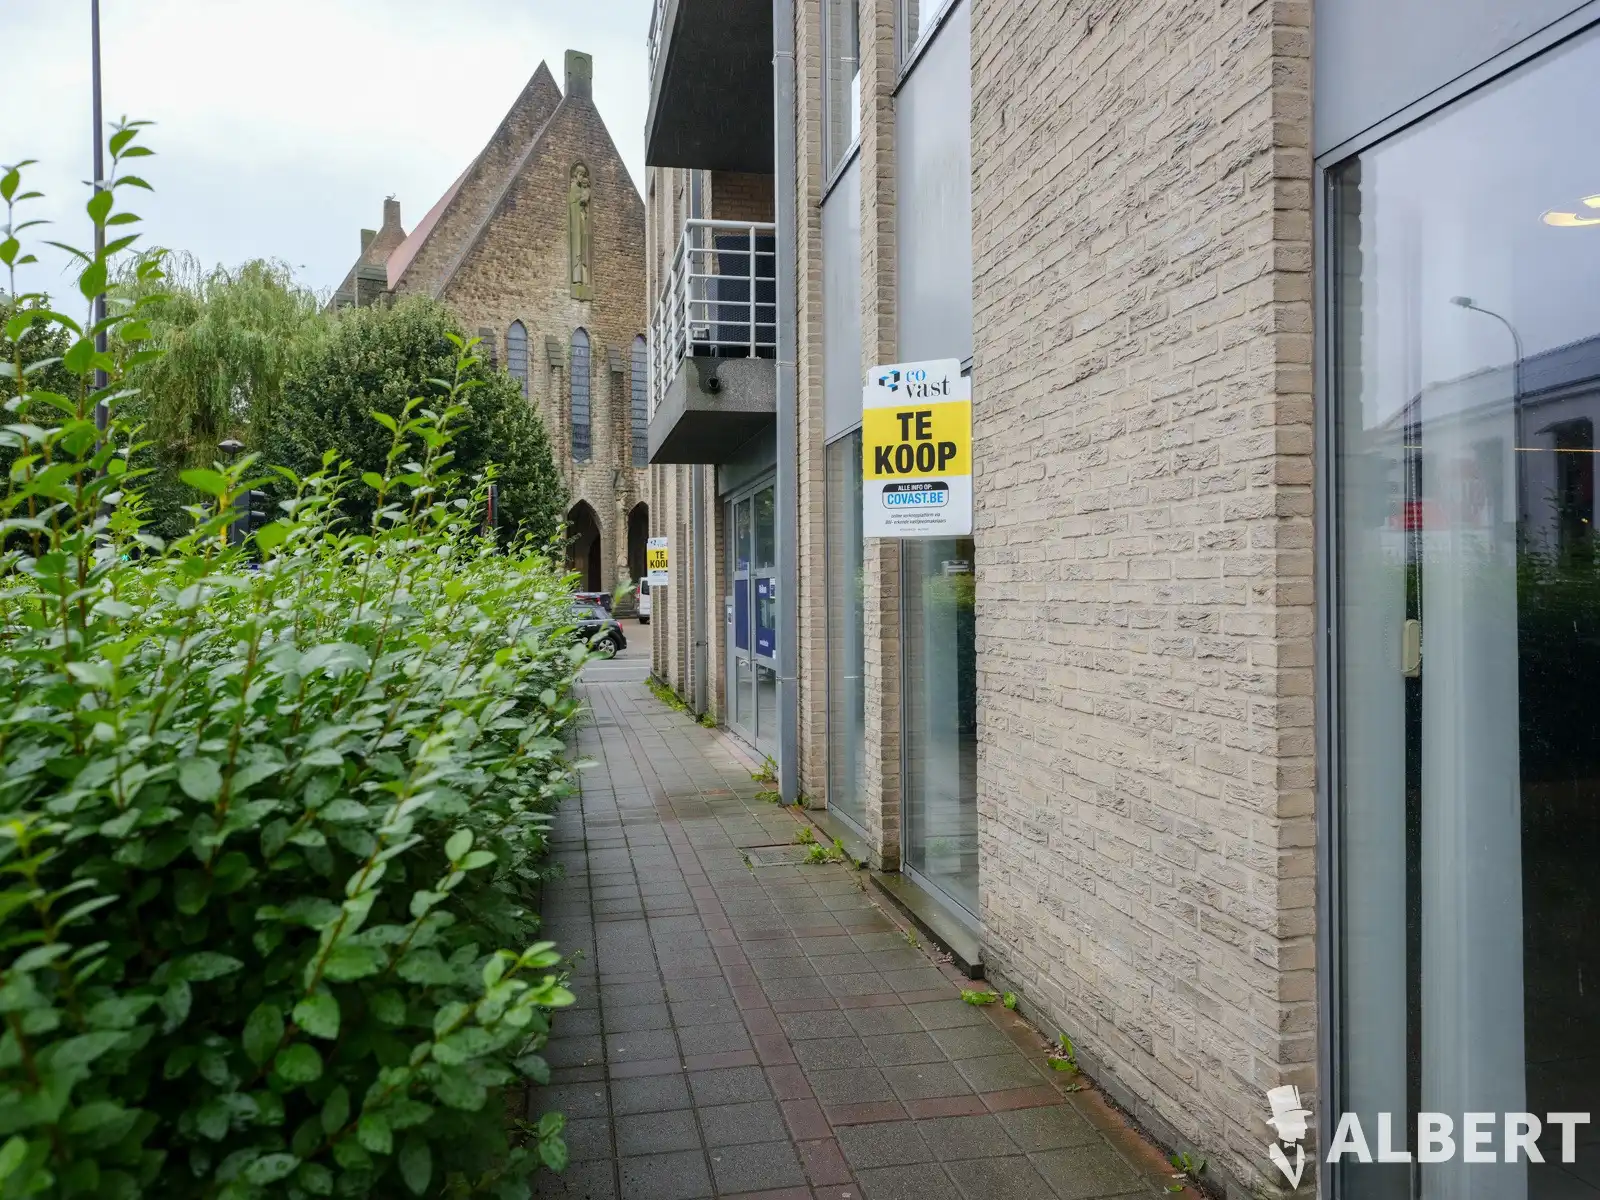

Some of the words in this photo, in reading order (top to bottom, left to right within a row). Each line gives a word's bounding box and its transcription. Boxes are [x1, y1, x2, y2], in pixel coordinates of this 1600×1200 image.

[906, 369, 926, 383] co
[906, 375, 951, 399] vast
[896, 410, 933, 441] TE
[874, 441, 957, 475] KOOP
[887, 492, 944, 504] COVAST.BE
[655, 550, 665, 559] TE
